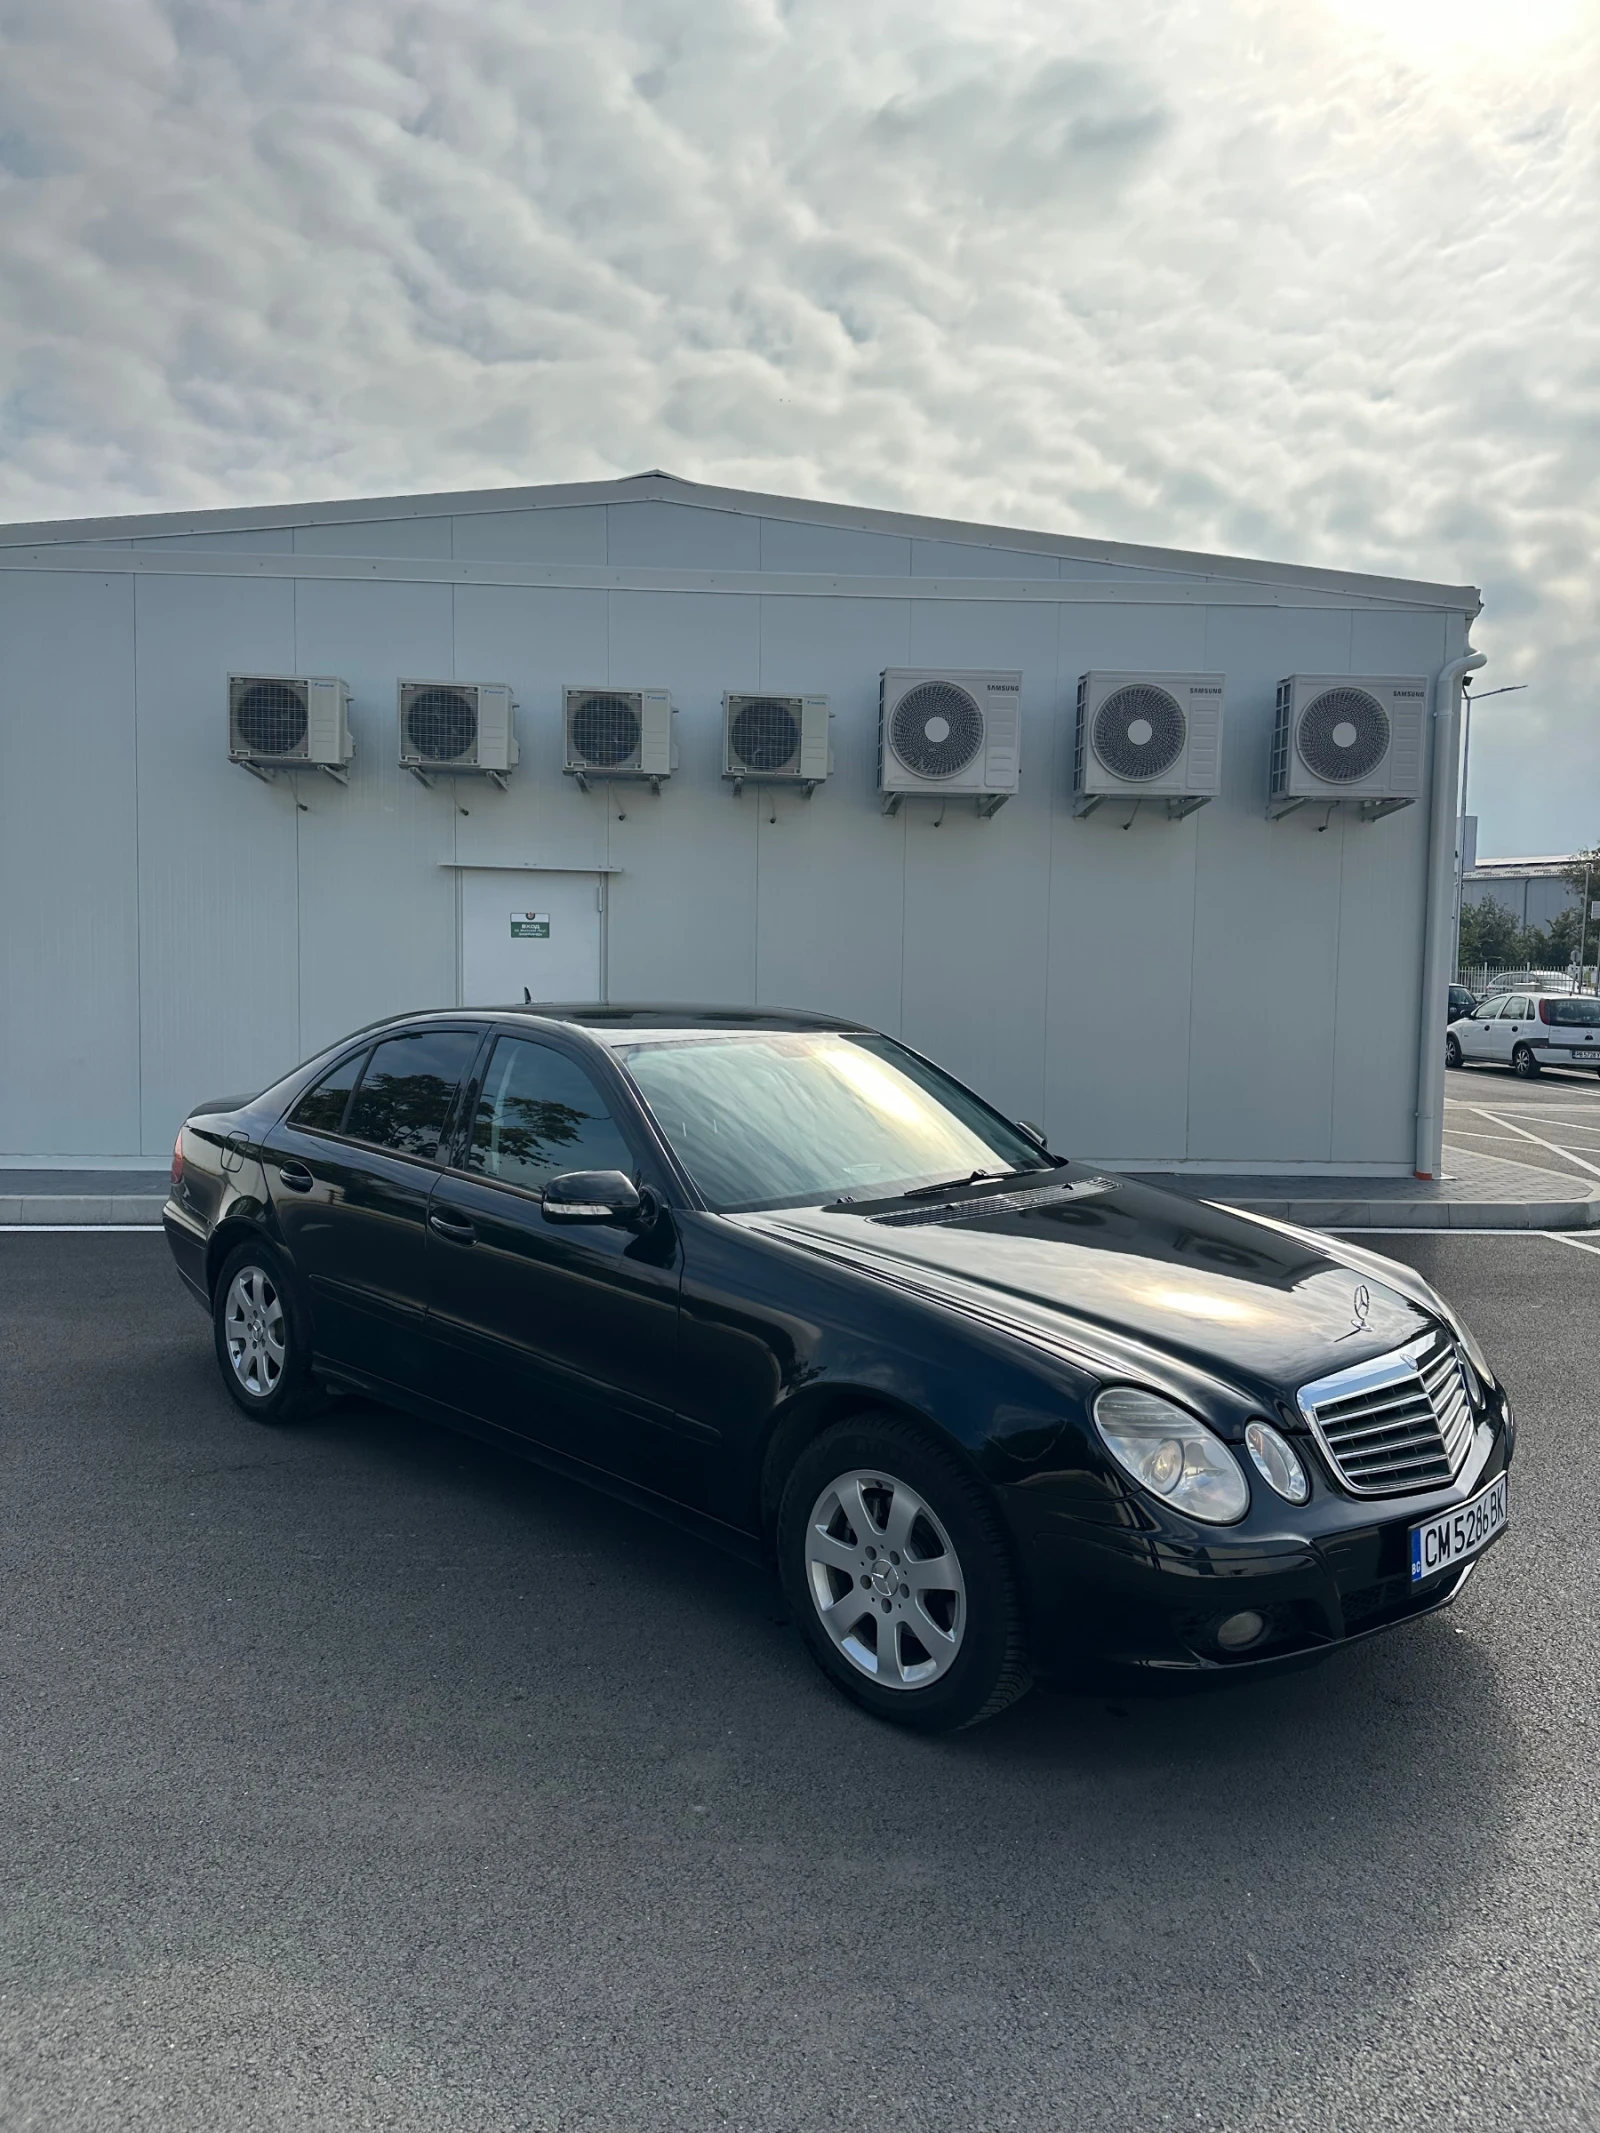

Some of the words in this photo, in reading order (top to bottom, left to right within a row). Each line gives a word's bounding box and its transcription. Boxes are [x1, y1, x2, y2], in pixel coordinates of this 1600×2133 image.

[1425, 1521, 1451, 1568] CM
[1454, 1498, 1489, 1553] 5286
[1490, 1483, 1505, 1528] BK
[1411, 1561, 1421, 1575] BG
